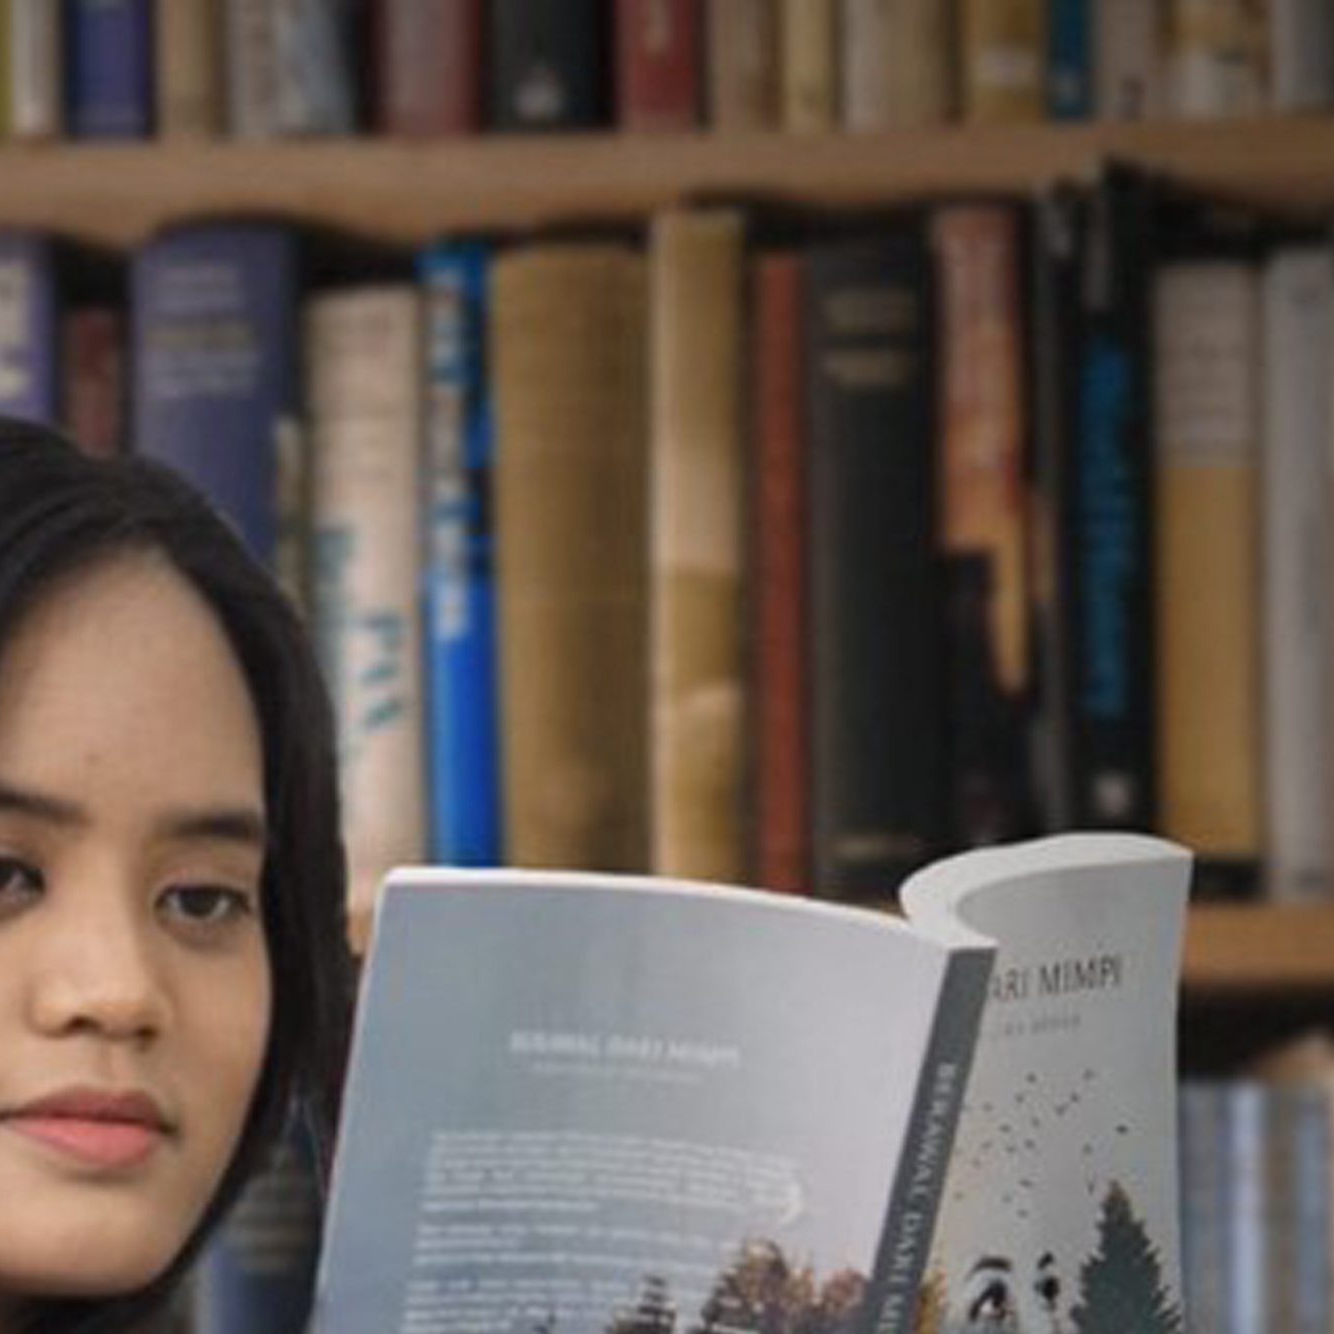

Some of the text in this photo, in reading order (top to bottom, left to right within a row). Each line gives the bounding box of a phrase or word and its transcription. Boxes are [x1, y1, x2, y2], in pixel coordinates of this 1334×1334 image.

[1040, 954, 1123, 996] MIMPI
[908, 1062, 958, 1200] BERAWAL
[888, 1212, 924, 1282] DARI
